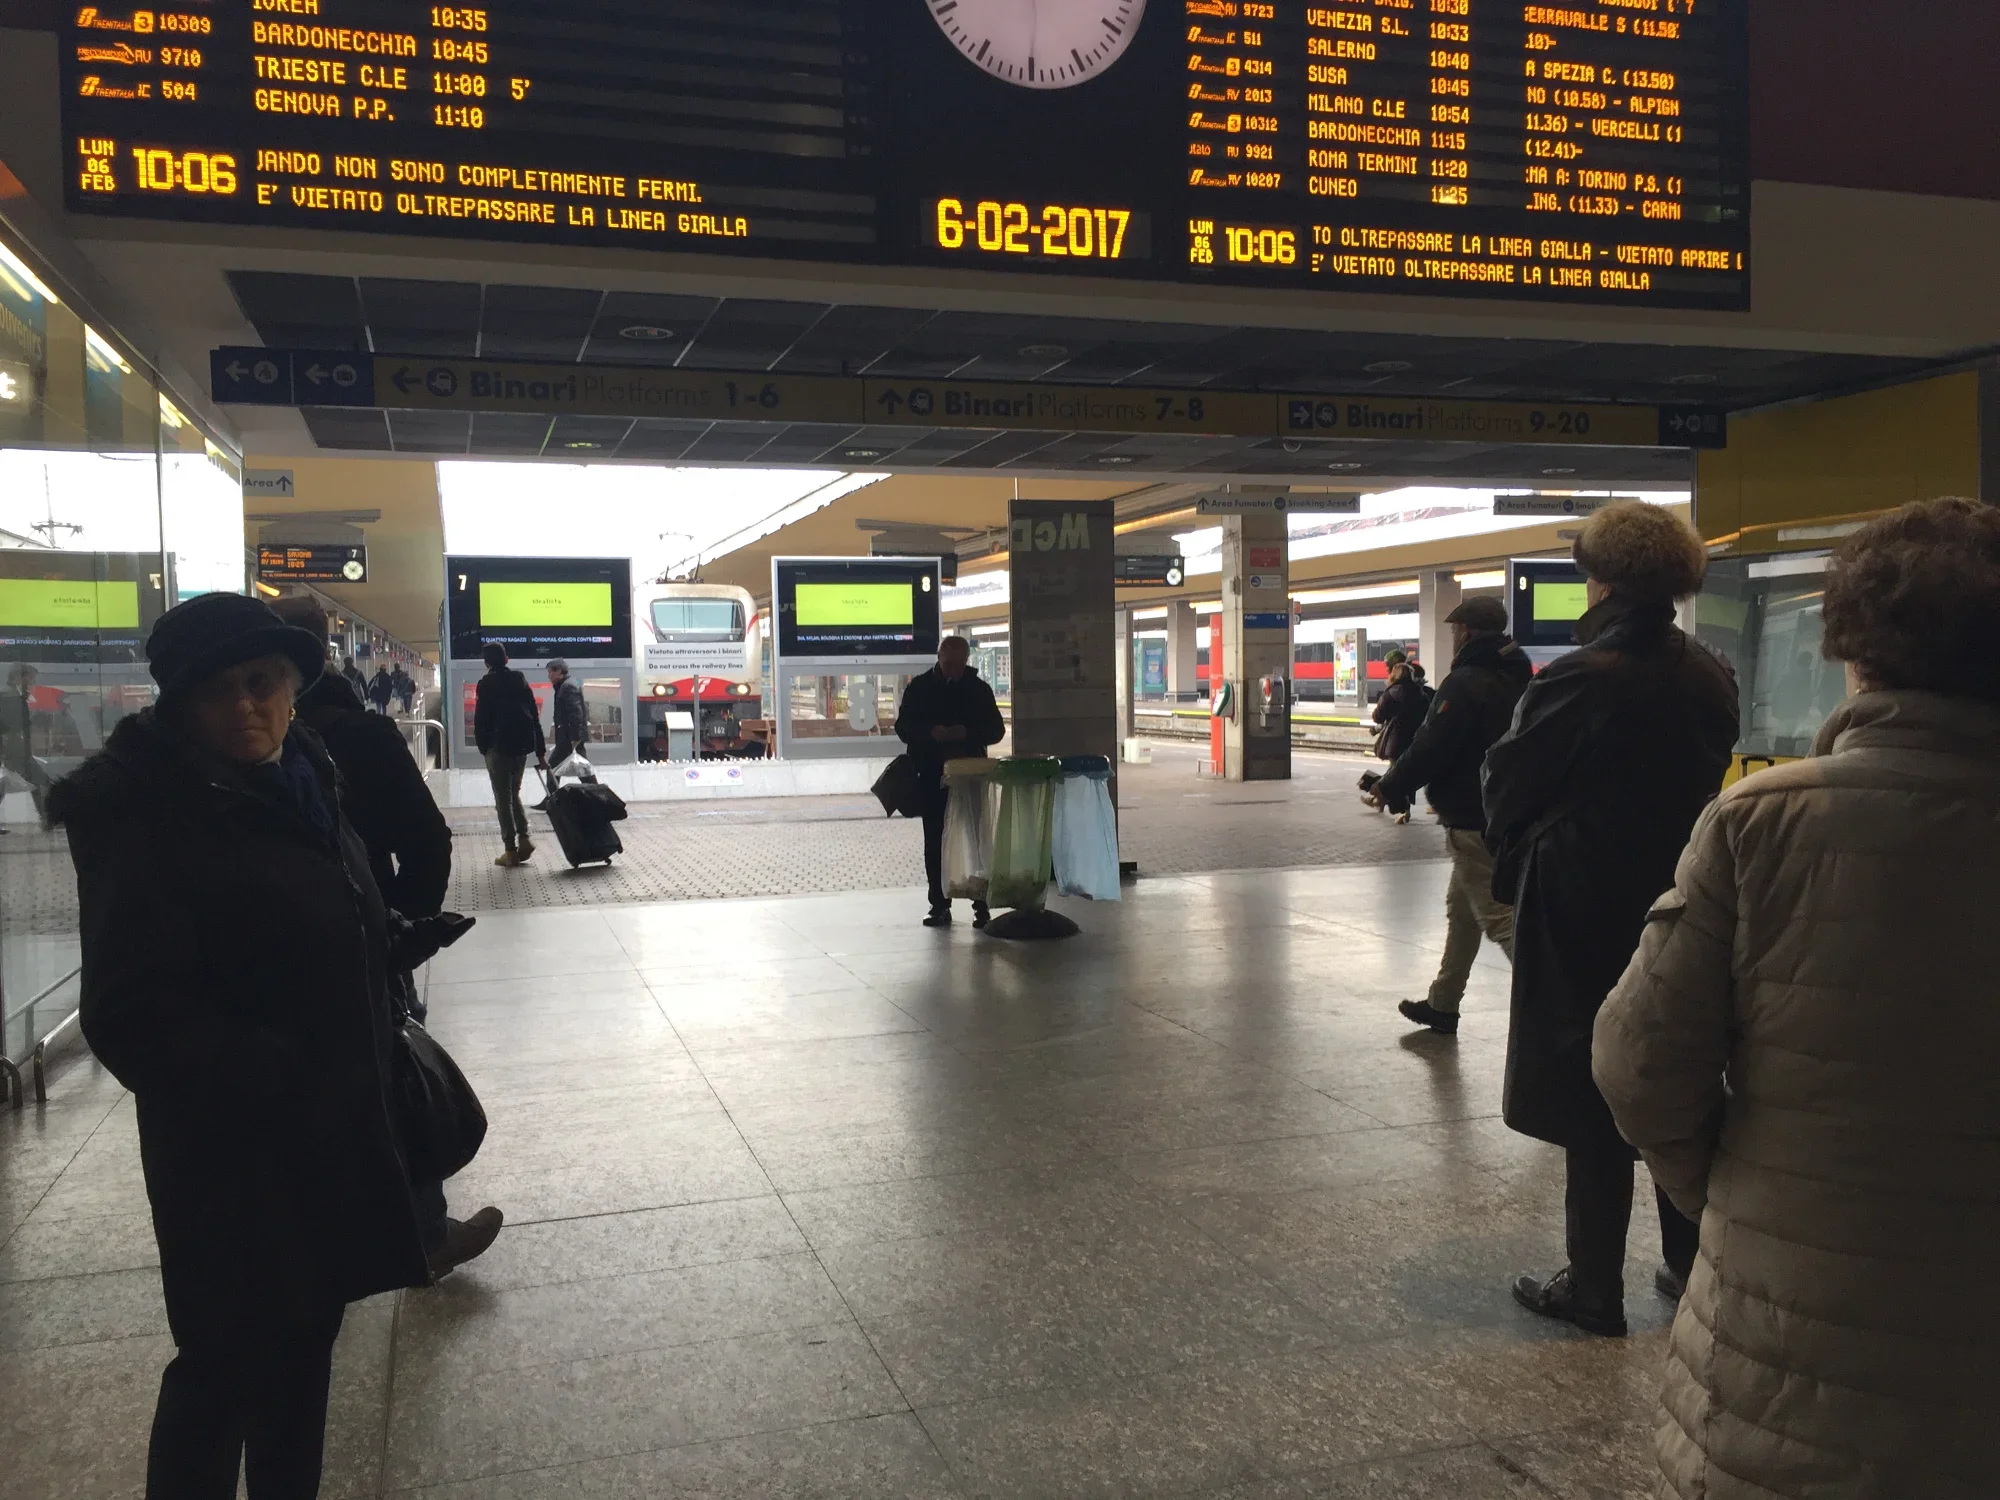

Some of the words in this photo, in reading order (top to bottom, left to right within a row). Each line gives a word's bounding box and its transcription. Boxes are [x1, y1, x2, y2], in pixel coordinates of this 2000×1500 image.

[1244, 4, 1273, 18] 9723
[1431, 0, 1468, 15] 10:30
[160, 14, 210, 33] 10309
[432, 7, 486, 31] 10:35
[1307, 9, 1371, 31] VENEZIA
[1382, 17, 1408, 35] S.L.
[254, 22, 416, 56] BARDONECCHIA
[1244, 32, 1261, 45] 511
[1431, 23, 1468, 41] 10:33
[161, 48, 201, 67] 9710
[433, 39, 487, 63] 10:45
[1308, 38, 1375, 60] SALERNO
[1244, 60, 1271, 74] 4314
[1431, 51, 1469, 70] 10:40
[255, 56, 345, 84] TRIESTE
[361, 65, 406, 89] C.LE
[1309, 65, 1346, 84] SUSA
[1526, 60, 1535, 76] A
[1544, 62, 1594, 82] SPEZIA
[1603, 68, 1616, 84] C.
[1624, 70, 1674, 90] (13.50)
[163, 81, 195, 100] 504
[434, 72, 485, 96] 11:00
[512, 79, 529, 100] 5'
[1431, 78, 1469, 96] 10:45
[255, 89, 339, 116] GENOVA
[355, 97, 393, 120] P.P.
[1245, 88, 1272, 102] 2013
[1527, 86, 1546, 104] NO
[1309, 94, 1363, 114] MILANO
[1373, 99, 1404, 118] C.LE
[1431, 105, 1469, 123] 10:54
[435, 105, 483, 128] 11:10
[1246, 116, 1277, 131] 10312
[1309, 121, 1420, 146] BARDONECCHIA
[1592, 119, 1659, 140] VERCELLI
[80, 139, 114, 158] LUN
[1432, 132, 1465, 150] 11:15
[1246, 144, 1272, 159] 9921
[86, 157, 110, 175] 06
[133, 148, 236, 194] 10:06
[1309, 150, 1347, 169] ROMA
[1358, 153, 1417, 174] TERMINI
[1432, 159, 1467, 178] 11:20
[81, 172, 115, 191] FEB
[336, 156, 376, 178] NON
[391, 160, 444, 183] SONO
[459, 166, 625, 196] COMPLETAMENTE
[639, 180, 701, 202] FERMI.
[1246, 172, 1280, 187] 10207
[1309, 176, 1357, 197] CUNEO
[1578, 170, 1626, 190] TORINO
[1635, 174, 1660, 193] P.S.
[1432, 186, 1467, 205] 11:25
[258, 184, 278, 204] E'
[292, 187, 382, 211] VIETATO
[397, 194, 554, 223] OLTREPASSARE
[569, 206, 594, 226] LA
[607, 209, 665, 231] LINEA
[678, 214, 746, 236] GIALLA
[1526, 193, 1561, 211] ING.
[1570, 196, 1618, 215] (11.33)
[1643, 200, 1680, 219] CARM
[938, 199, 1130, 258] 6-02-2017
[1190, 220, 1213, 234] LUN
[1195, 236, 1209, 248] 06
[1226, 227, 1295, 264] 10:06
[1313, 226, 1331, 244] TO
[1341, 228, 1452, 252] OLTREPASSARE
[1463, 235, 1480, 254] LA
[1490, 237, 1531, 256] LINEA
[1541, 240, 1591, 260] GIALLA
[1617, 245, 1673, 265] VIETATO
[1681, 249, 1728, 269] APRIRE
[1191, 246, 1213, 263] FEB
[1334, 255, 1395, 276] VIETATO
[1405, 259, 1514, 282] OLTREPASSARE
[1524, 266, 1541, 284] LA
[1550, 268, 1591, 286] LINEA
[1600, 270, 1649, 290] GIALLA
[470, 371, 576, 401] Binari
[584, 374, 709, 406] Platforms
[726, 381, 779, 409] 1-6
[945, 392, 1033, 417] Binari
[1039, 393, 1145, 421] Platforms
[1156, 398, 1204, 421] 7-8
[1347, 405, 1422, 429] Binari
[1428, 407, 1522, 434] Platforms
[1530, 411, 1589, 434] 9-20
[244, 478, 274, 488] Area
[1212, 500, 1232, 508] Area
[1235, 500, 1272, 508] Fumatori
[1288, 500, 1322, 509] Smoking
[1326, 500, 1349, 508] Area
[1528, 501, 1560, 509] Fumatori
[352, 549, 358, 558] 7
[458, 575, 466, 591] 7
[922, 576, 930, 592] 8
[1520, 576, 1526, 590] 9
[849, 682, 877, 731] 8
